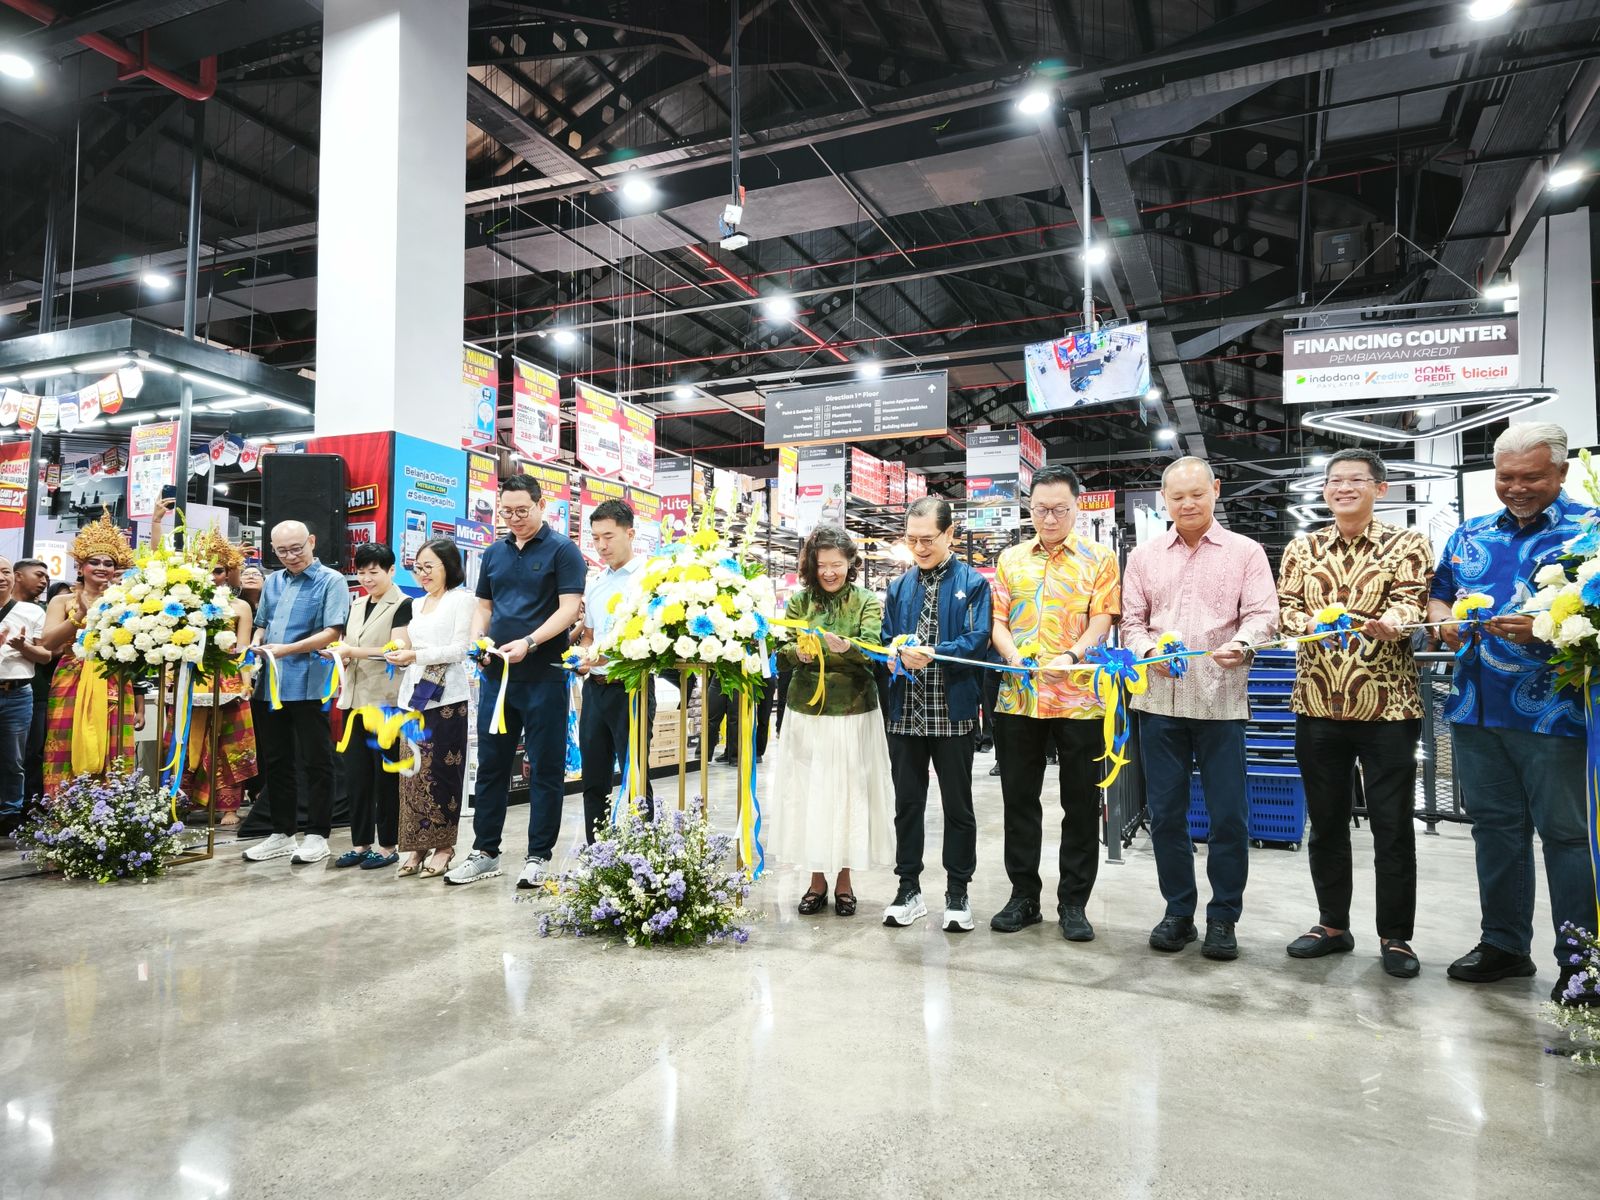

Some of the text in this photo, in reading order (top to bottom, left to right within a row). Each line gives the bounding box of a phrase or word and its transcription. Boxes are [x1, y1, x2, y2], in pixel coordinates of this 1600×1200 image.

[1293, 325, 1507, 355] FINANCING COUNTER
[1329, 346, 1460, 364] PEMBIAYAAN KREDIT
[1309, 373, 1360, 383] indodana
[1414, 365, 1508, 379] HOME blicicil
[1414, 373, 1456, 383] CREDIT
[825, 393, 854, 402] Direction
[405, 466, 430, 480] Belanja
[430, 473, 450, 484] Online
[50, 555, 62, 577] 3
